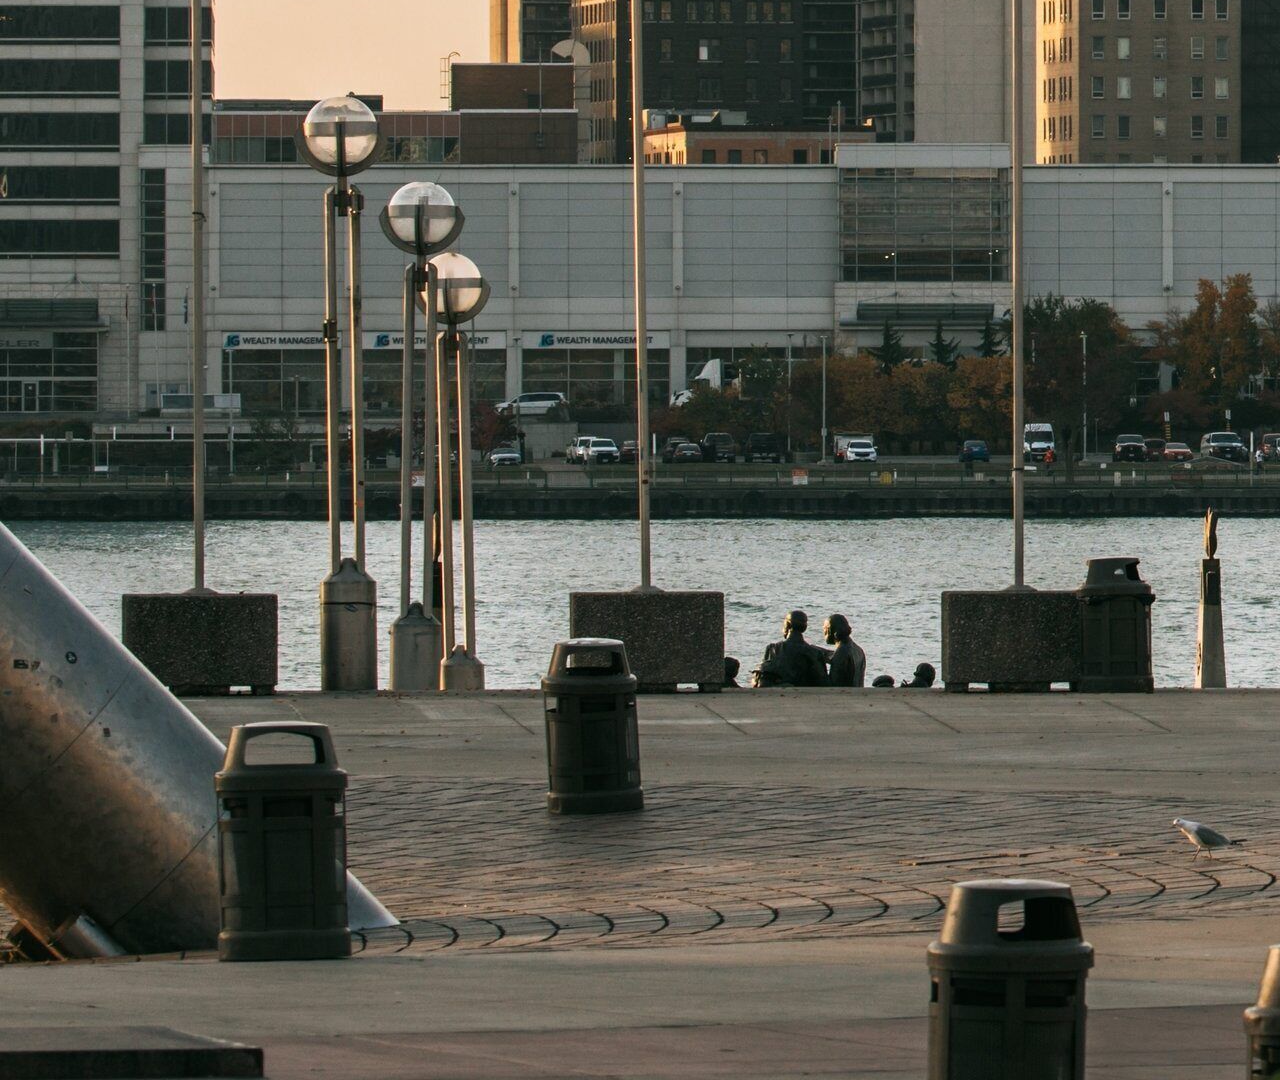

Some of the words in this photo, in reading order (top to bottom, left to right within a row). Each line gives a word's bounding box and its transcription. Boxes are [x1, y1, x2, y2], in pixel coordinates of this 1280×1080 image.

[226, 335, 240, 347] IG
[376, 335, 390, 346] IG
[541, 334, 555, 346] IG
